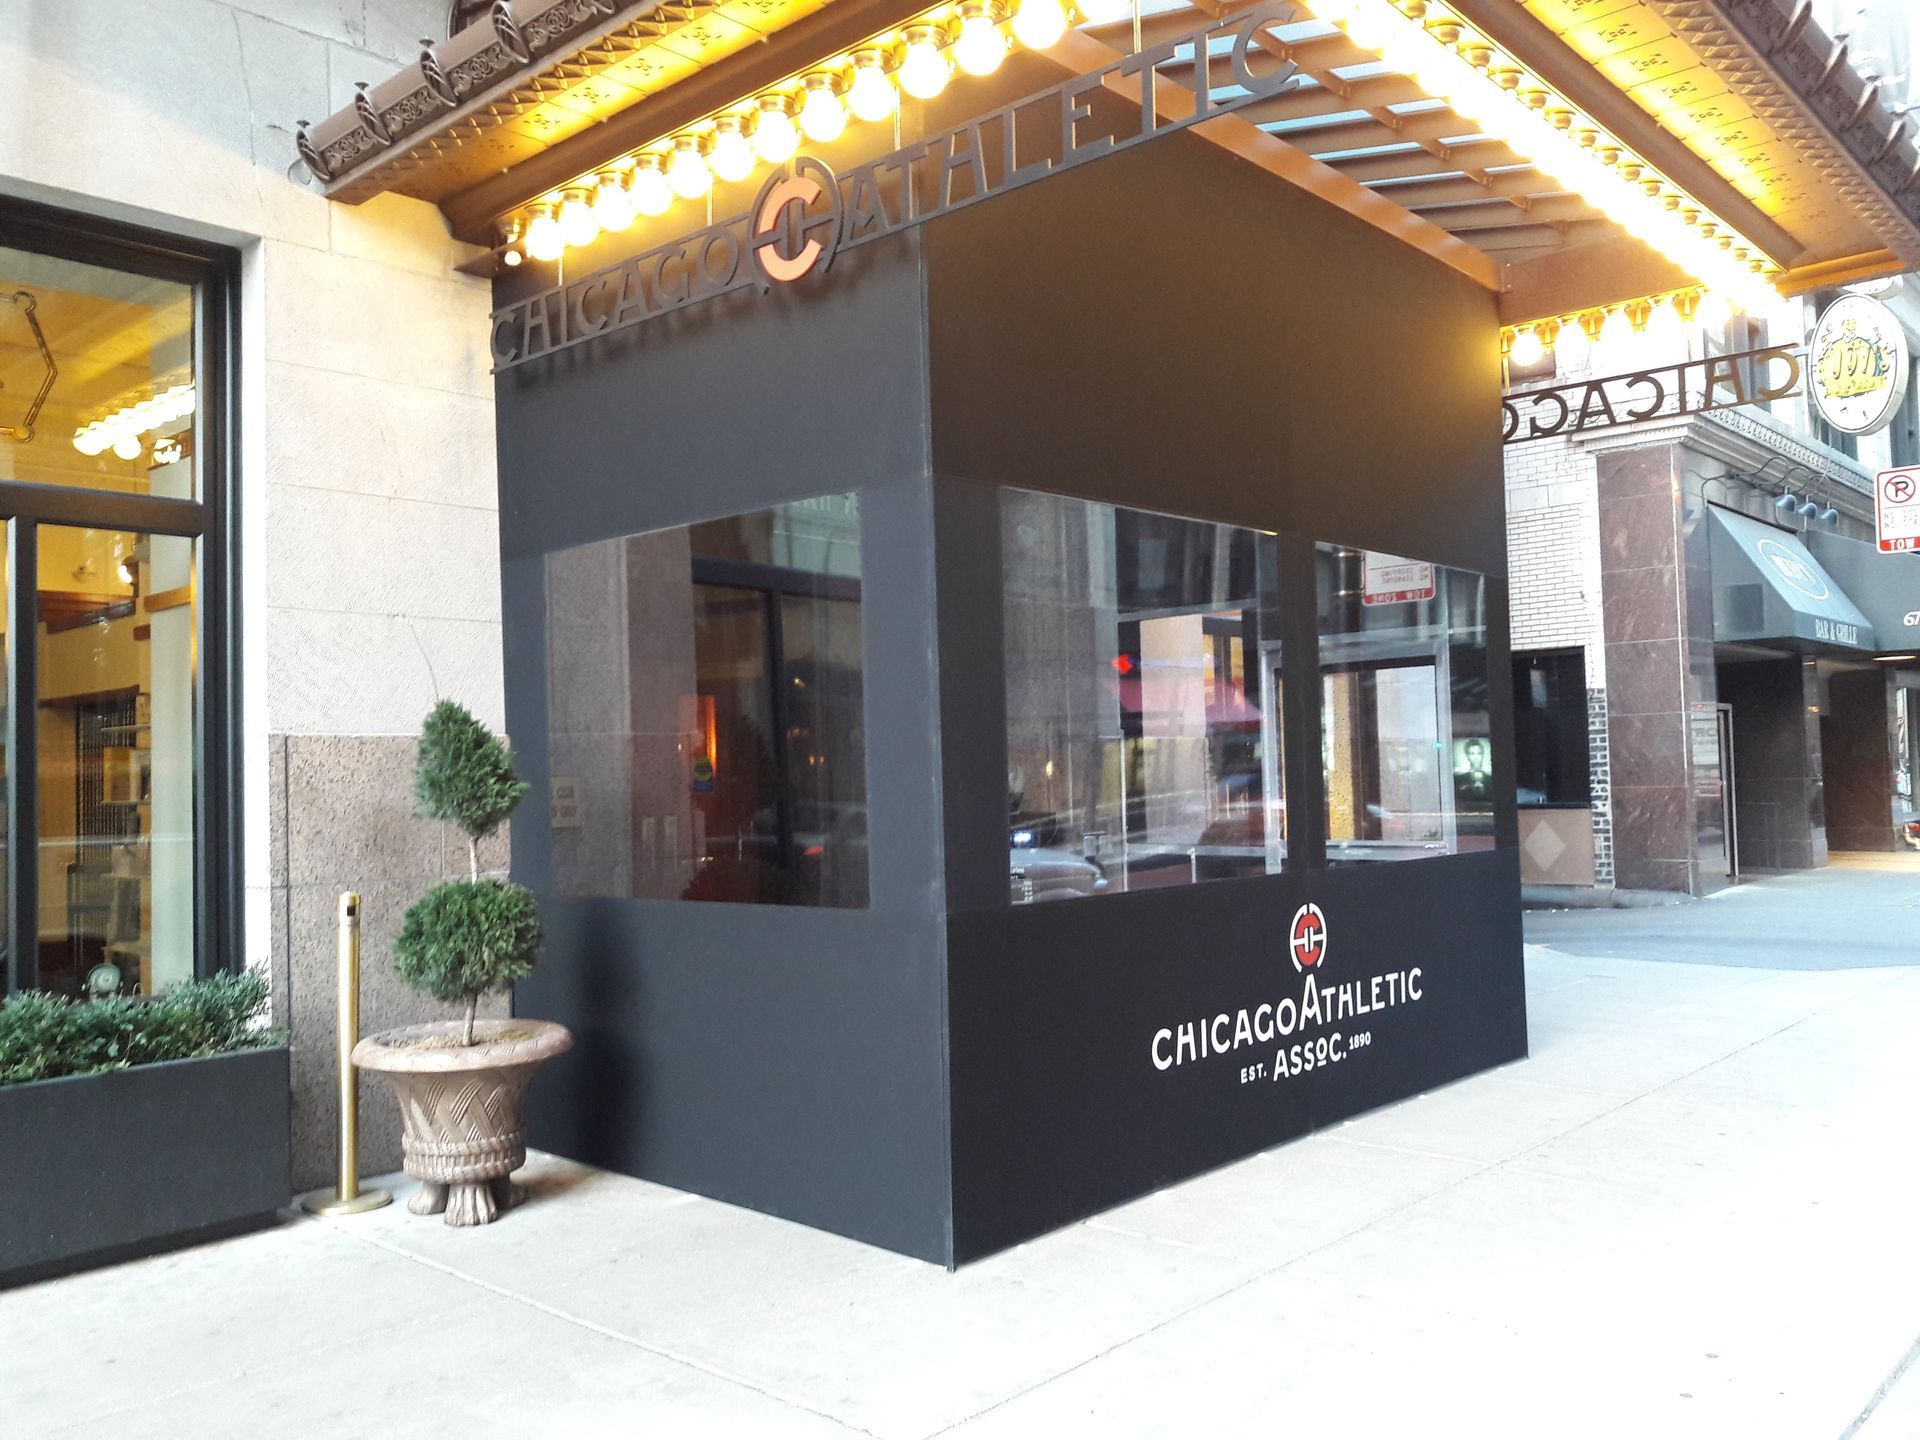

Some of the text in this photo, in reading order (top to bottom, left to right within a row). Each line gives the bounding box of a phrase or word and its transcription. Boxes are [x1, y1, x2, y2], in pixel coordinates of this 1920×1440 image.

[489, 226, 742, 370] CHICAGO
[842, 2, 1298, 245] ATHLETIC
[1890, 537, 1916, 551] TOW
[1815, 618, 1829, 639] BAR
[1151, 967, 1423, 1071] CHICAGO ATHLETIC
[1240, 1063, 1267, 1084] EST.
[1349, 1031, 1371, 1050] 1890
